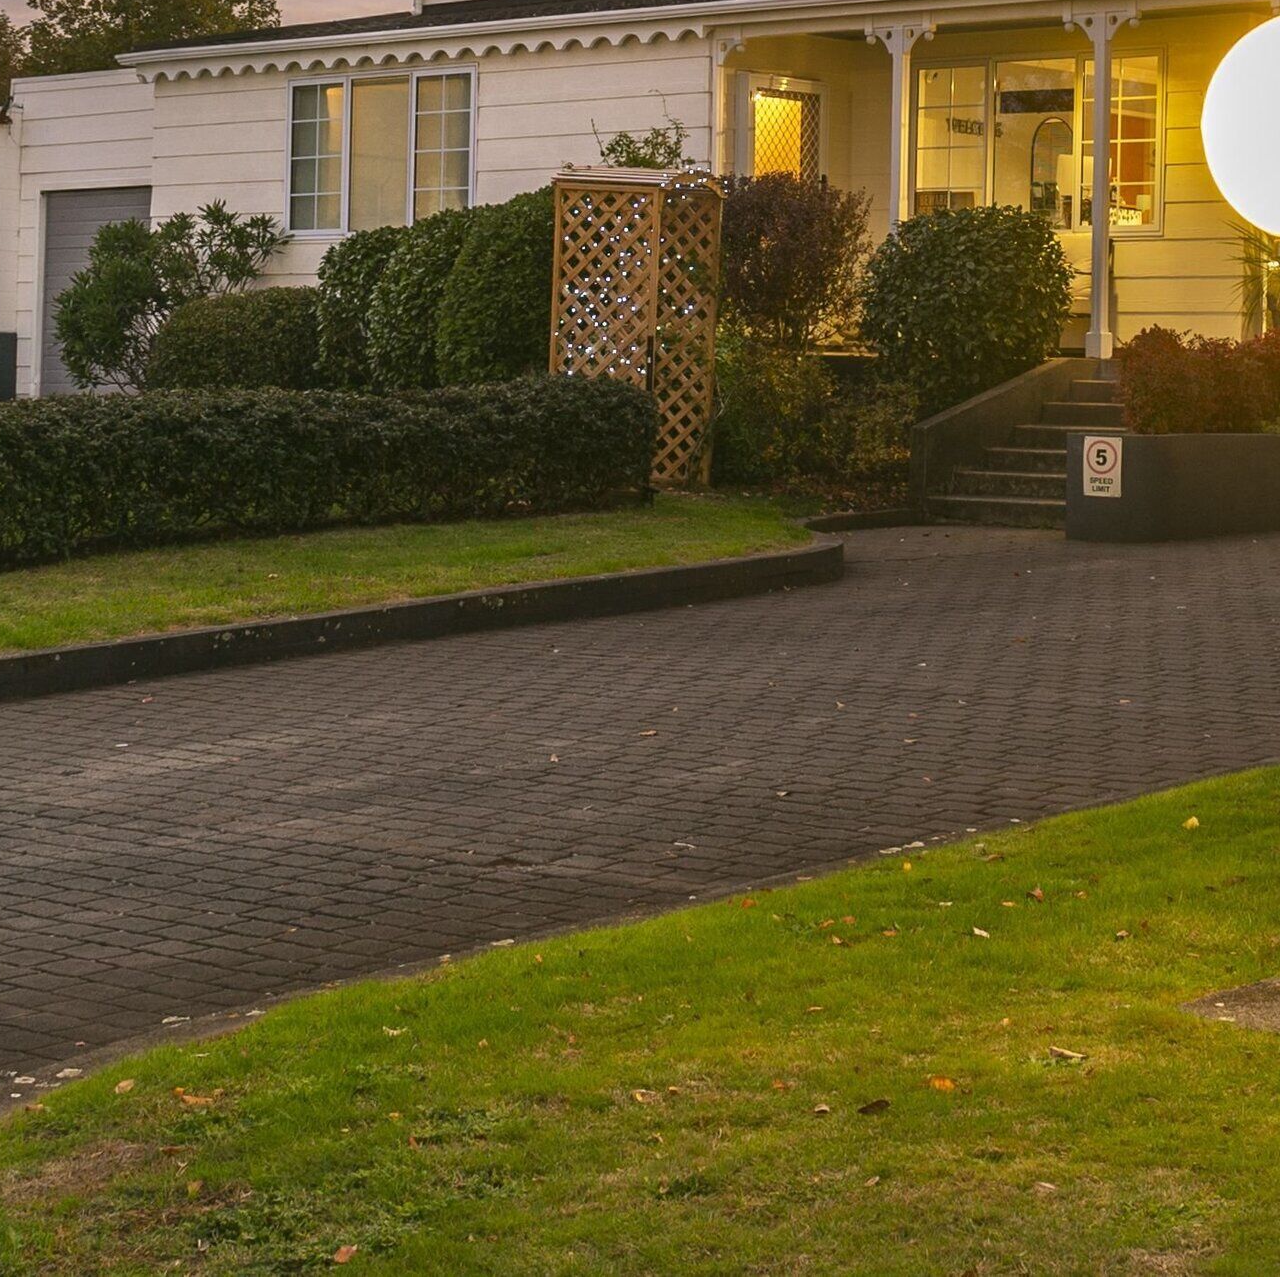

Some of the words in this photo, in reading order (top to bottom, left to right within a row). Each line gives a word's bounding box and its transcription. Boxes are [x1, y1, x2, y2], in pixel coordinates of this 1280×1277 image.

[1095, 448, 1108, 466] 5
[1089, 477, 1114, 485] SPEED
[1091, 485, 1110, 493] LIMIT
